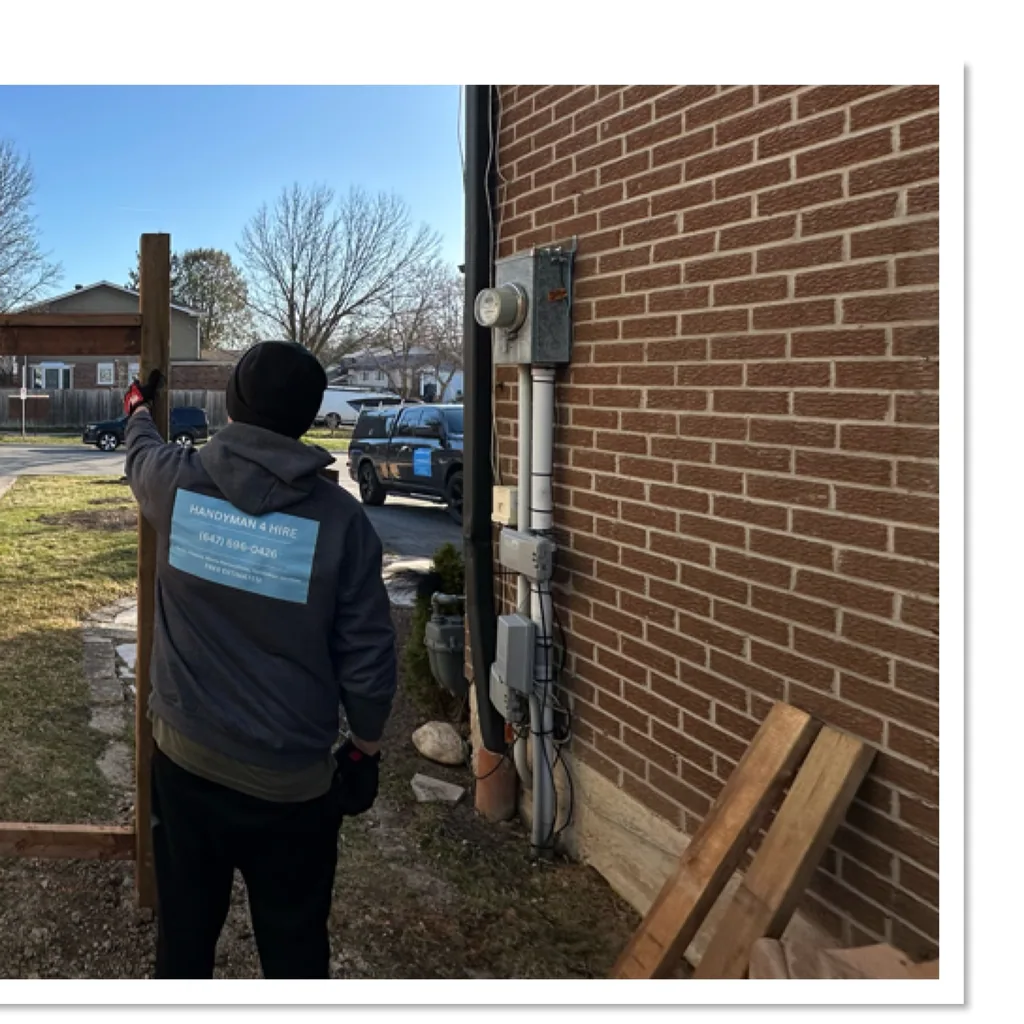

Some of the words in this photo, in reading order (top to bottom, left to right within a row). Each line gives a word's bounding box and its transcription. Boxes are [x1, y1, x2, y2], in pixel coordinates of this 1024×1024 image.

[190, 503, 256, 530] HANDYMAN
[259, 521, 266, 532] 4
[268, 524, 299, 539] HIRE
